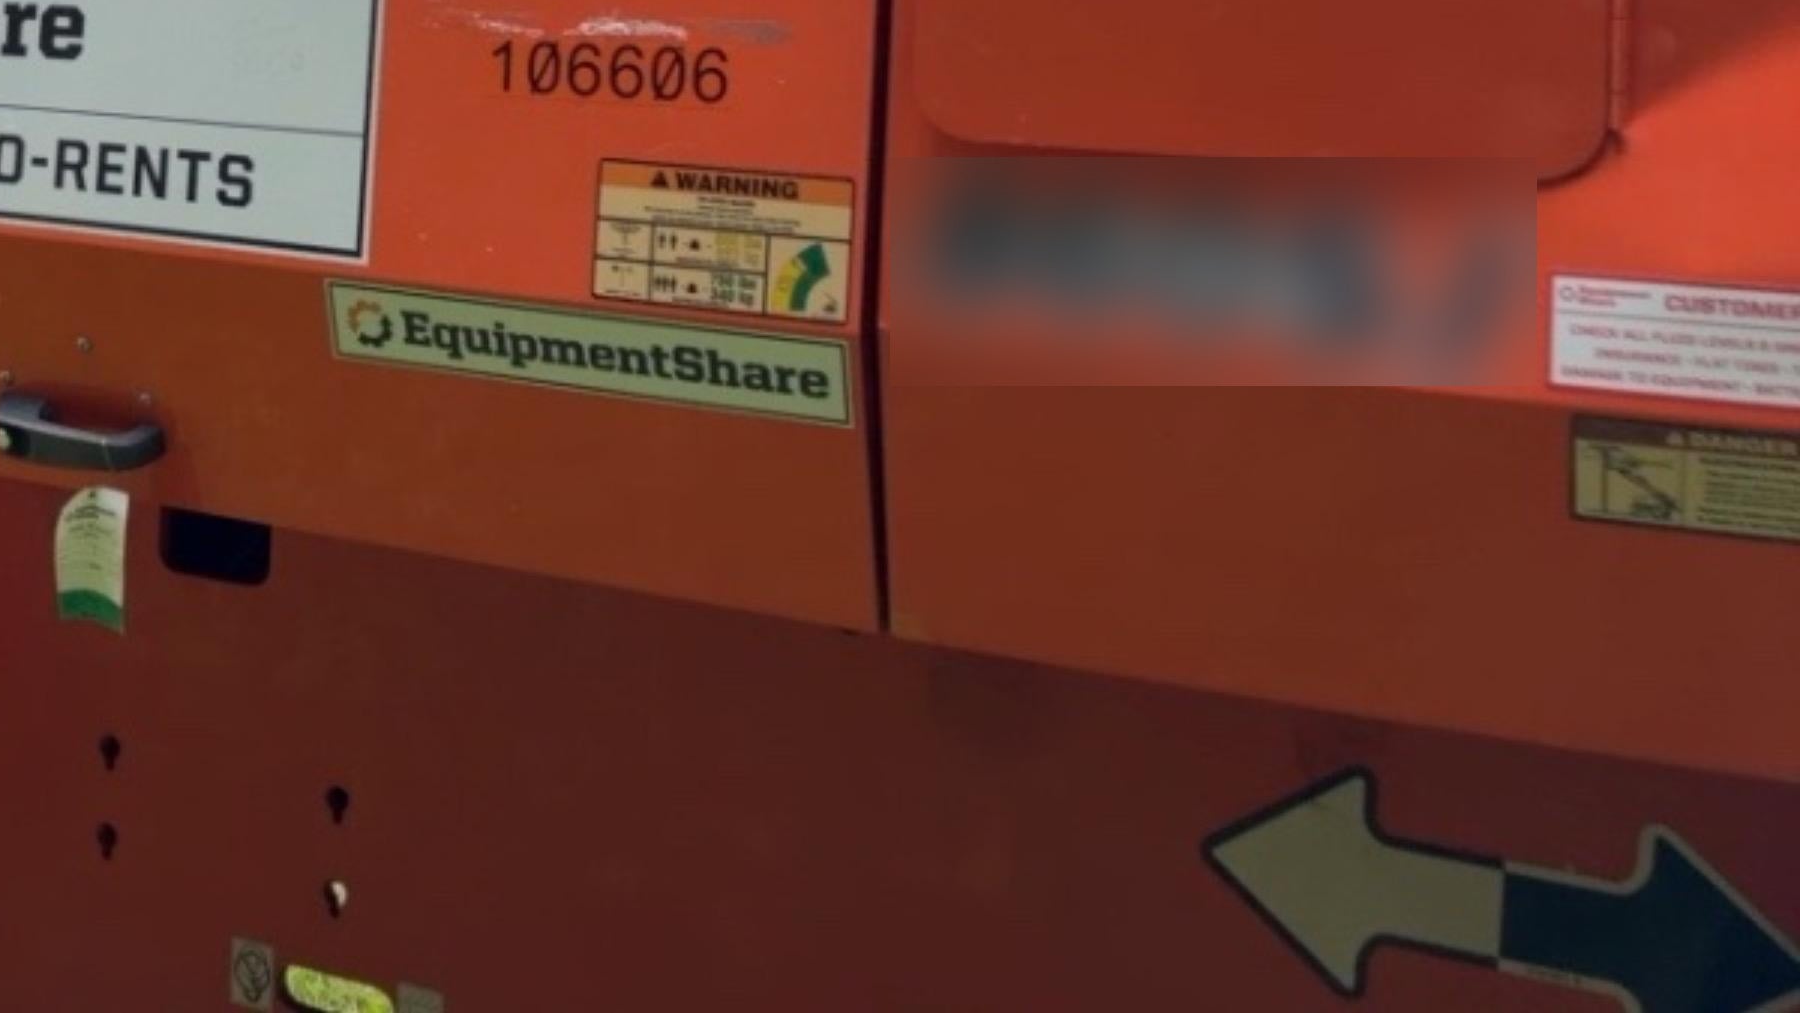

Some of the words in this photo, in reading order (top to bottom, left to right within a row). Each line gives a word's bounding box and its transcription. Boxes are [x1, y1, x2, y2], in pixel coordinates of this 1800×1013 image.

[492, 39, 729, 103] 106606
[675, 171, 799, 199] WARNING
[400, 310, 830, 399] EquipmentShare
